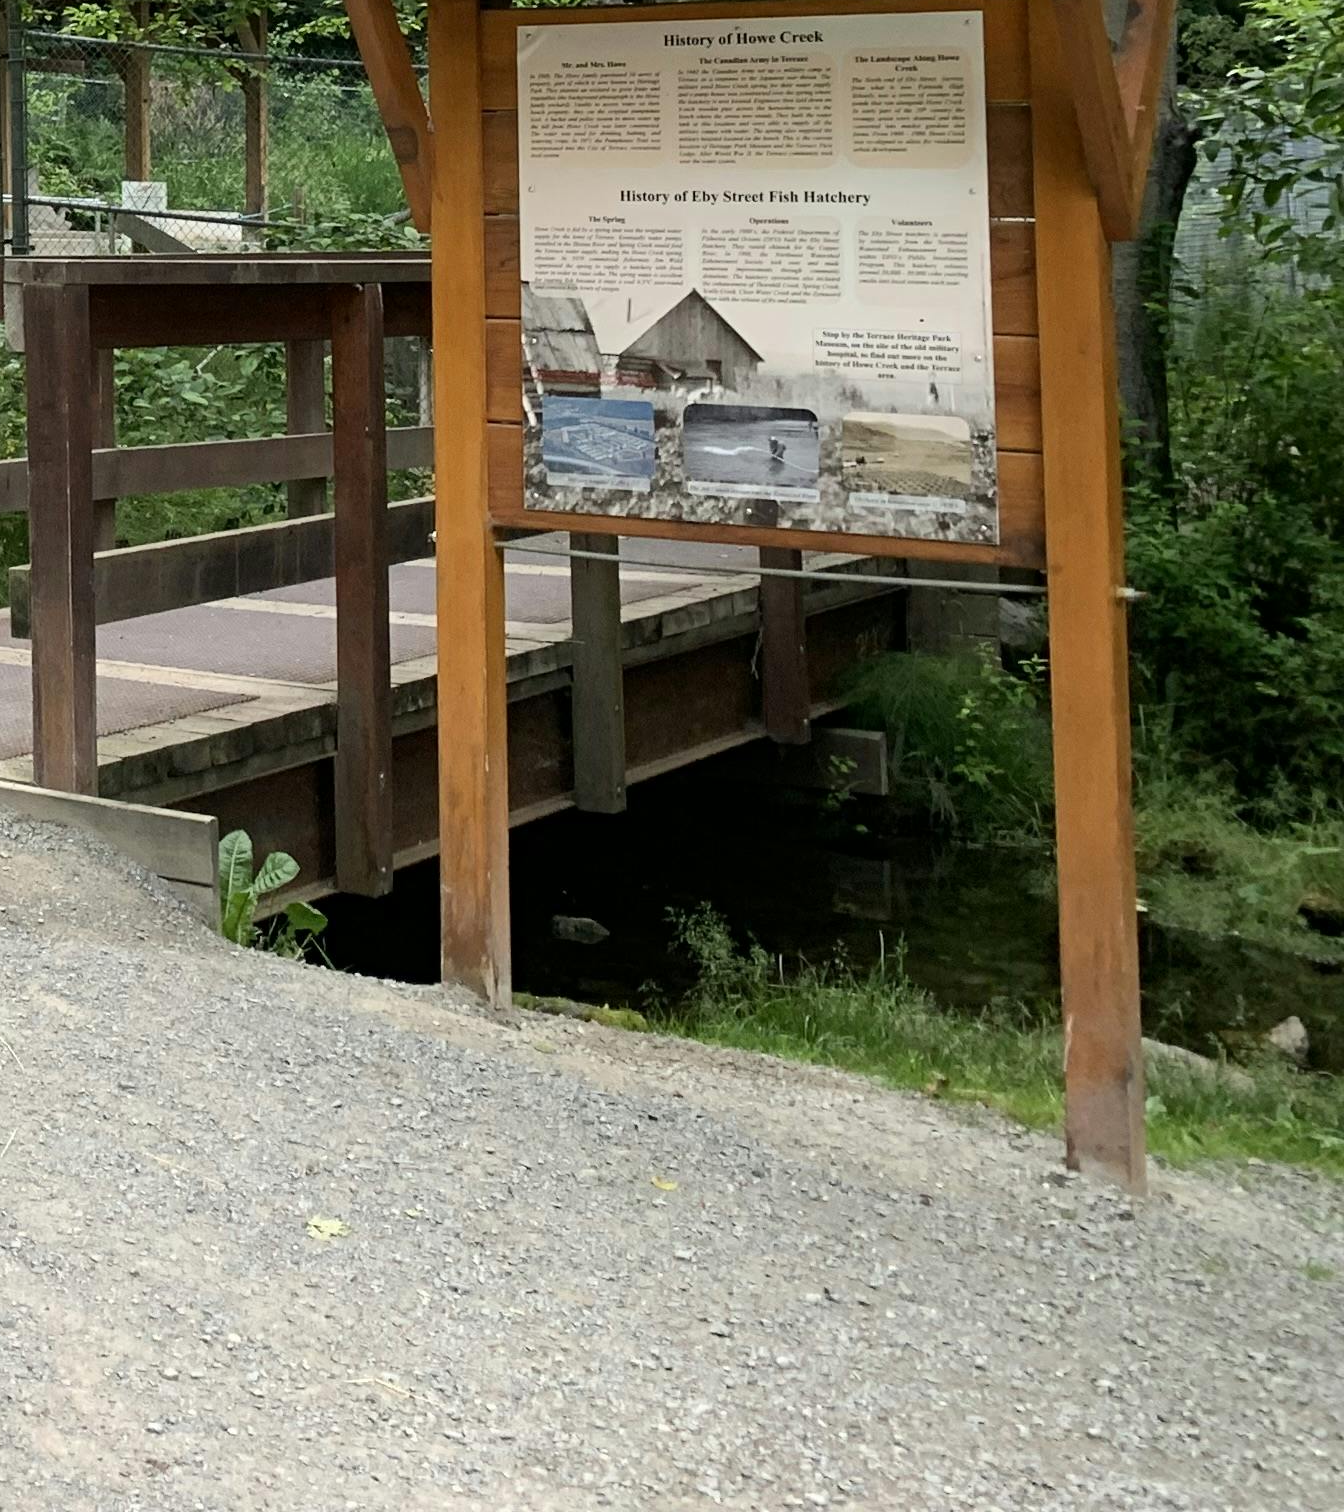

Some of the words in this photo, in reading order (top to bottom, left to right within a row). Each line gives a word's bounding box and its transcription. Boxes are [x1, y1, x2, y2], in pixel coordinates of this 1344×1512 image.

[664, 34, 714, 48] History
[718, 33, 733, 45] of
[736, 33, 776, 45] Howe
[780, 31, 824, 44] Creek
[620, 190, 669, 205] History
[674, 190, 688, 203] of
[692, 191, 717, 205] Eby
[723, 191, 764, 203] Street
[769, 191, 798, 203] Fish
[804, 191, 871, 206] Hatchery
[602, 216, 626, 224] Spring
[749, 218, 789, 226] Operations
[891, 219, 933, 227] Volunteers
[822, 331, 839, 340] Stop
[841, 331, 850, 339] by
[852, 331, 864, 339] the
[867, 332, 894, 340] Terrace
[897, 333, 930, 342] Heritage
[862, 341, 874, 349] the
[900, 342, 912, 350] the
[928, 345, 959, 353] military
[870, 351, 885, 359] find
[935, 354, 947, 362] the
[815, 360, 841, 368] history
[875, 362, 898, 370] Creek
[931, 365, 961, 373] Terrace
